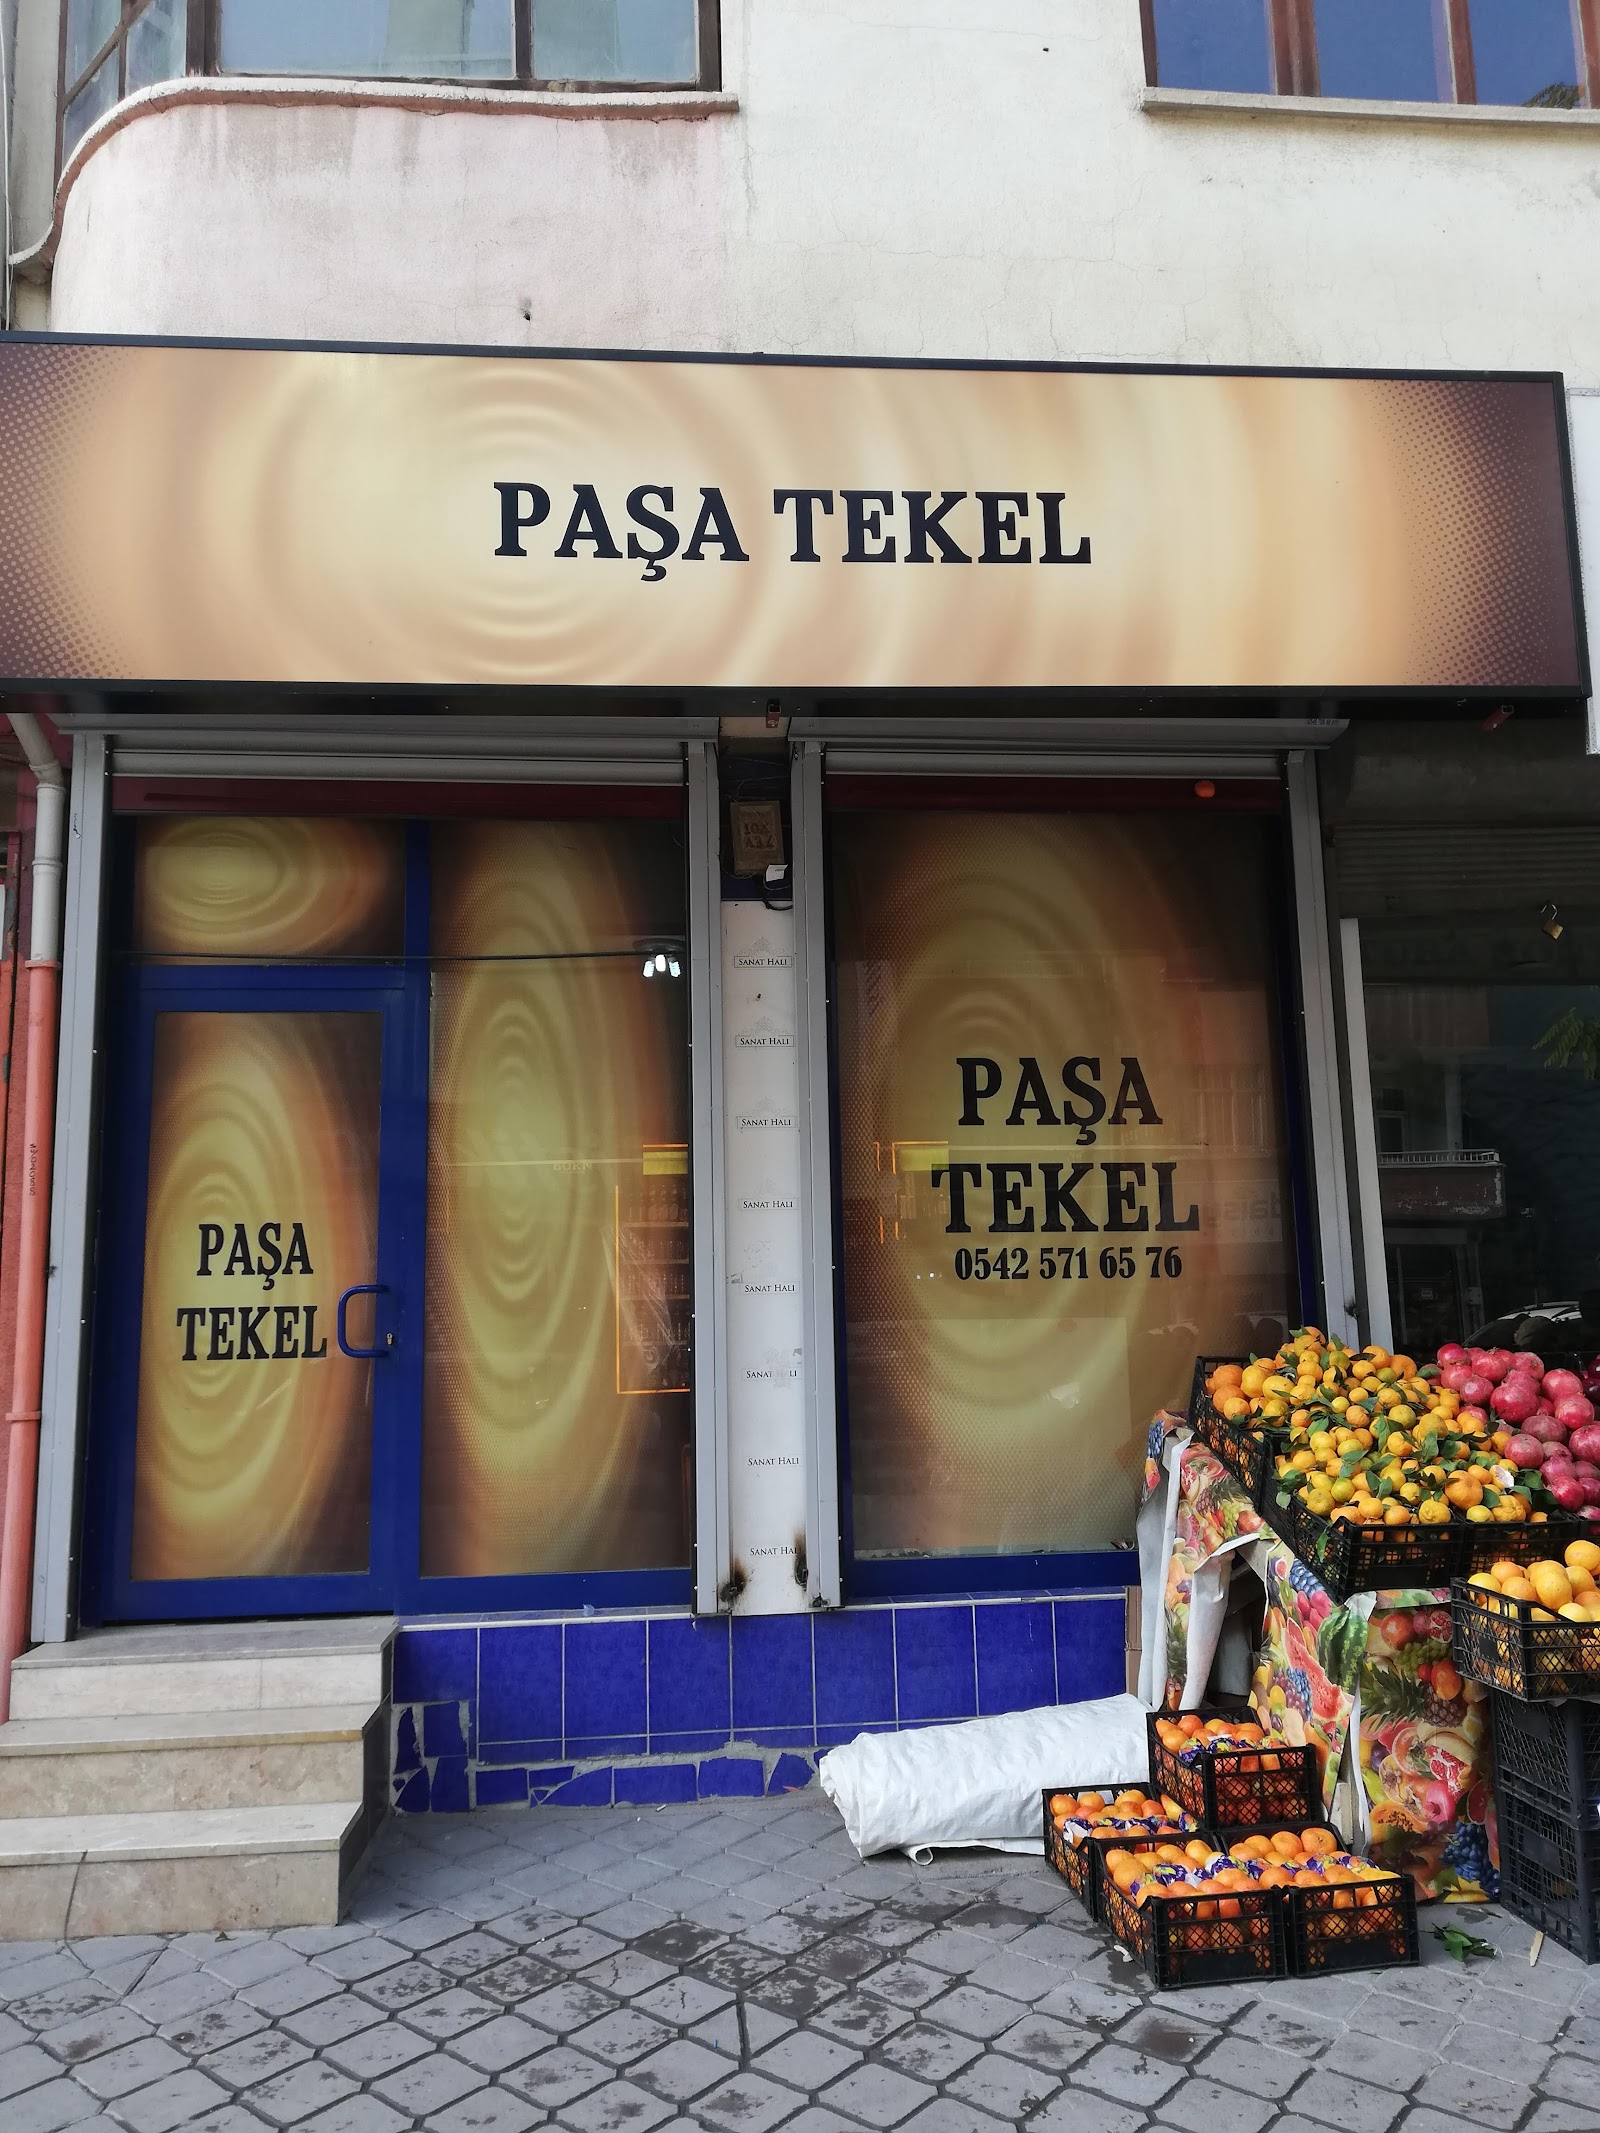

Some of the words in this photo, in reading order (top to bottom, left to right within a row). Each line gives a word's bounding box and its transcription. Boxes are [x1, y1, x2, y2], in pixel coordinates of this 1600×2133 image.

[494, 482, 749, 582] PAŞA
[774, 489, 1092, 564] TEKEL
[956, 1056, 1164, 1145] PAŞA
[931, 1162, 1200, 1233] TEKEL
[197, 1222, 314, 1291] PAŞA
[954, 1247, 1030, 1280] 0542
[1039, 1246, 1089, 1279] 571
[1099, 1246, 1136, 1279] 65
[1145, 1246, 1183, 1278] 76
[176, 1305, 328, 1361] TEKEL
